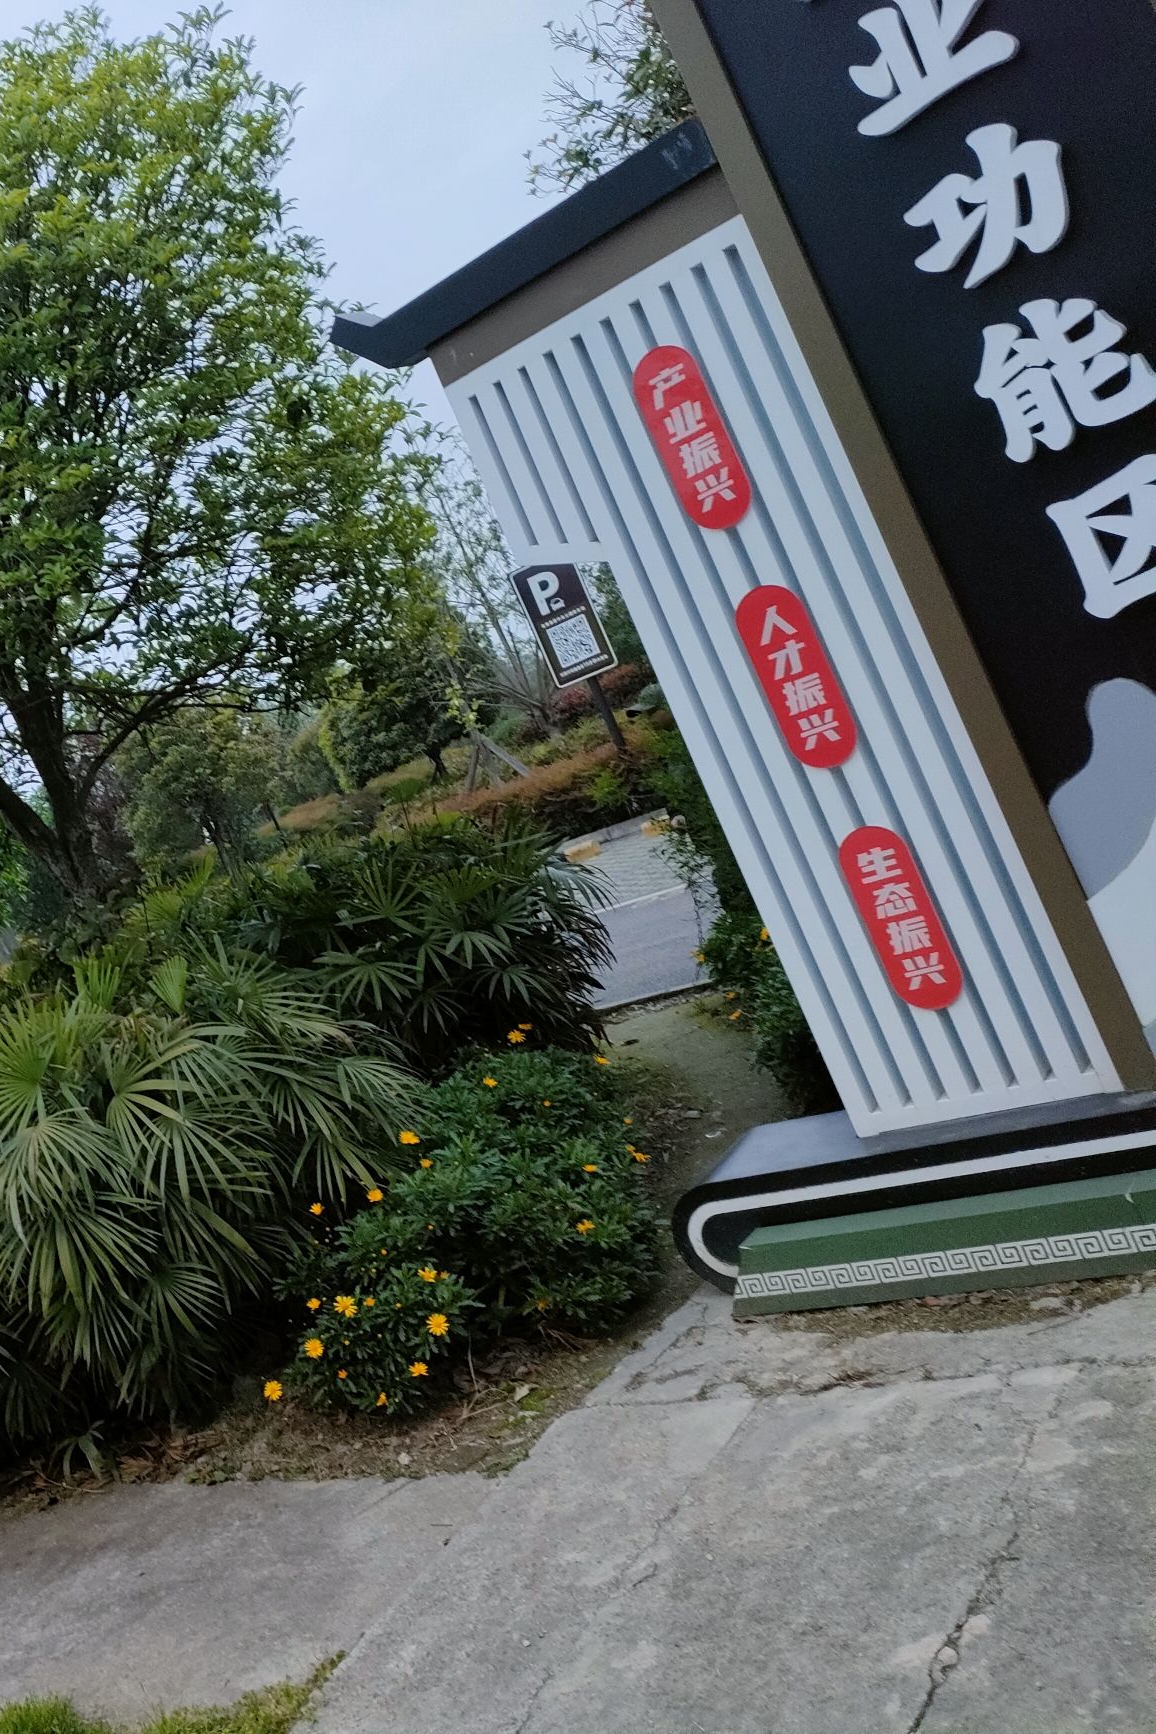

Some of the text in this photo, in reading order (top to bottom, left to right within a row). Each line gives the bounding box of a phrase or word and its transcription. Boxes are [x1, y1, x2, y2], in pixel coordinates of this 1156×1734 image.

[648, 362, 737, 513] 产业振兴
[526, 571, 560, 616] P
[760, 604, 843, 751] 人才振兴
[856, 846, 947, 991] 生态振兴
